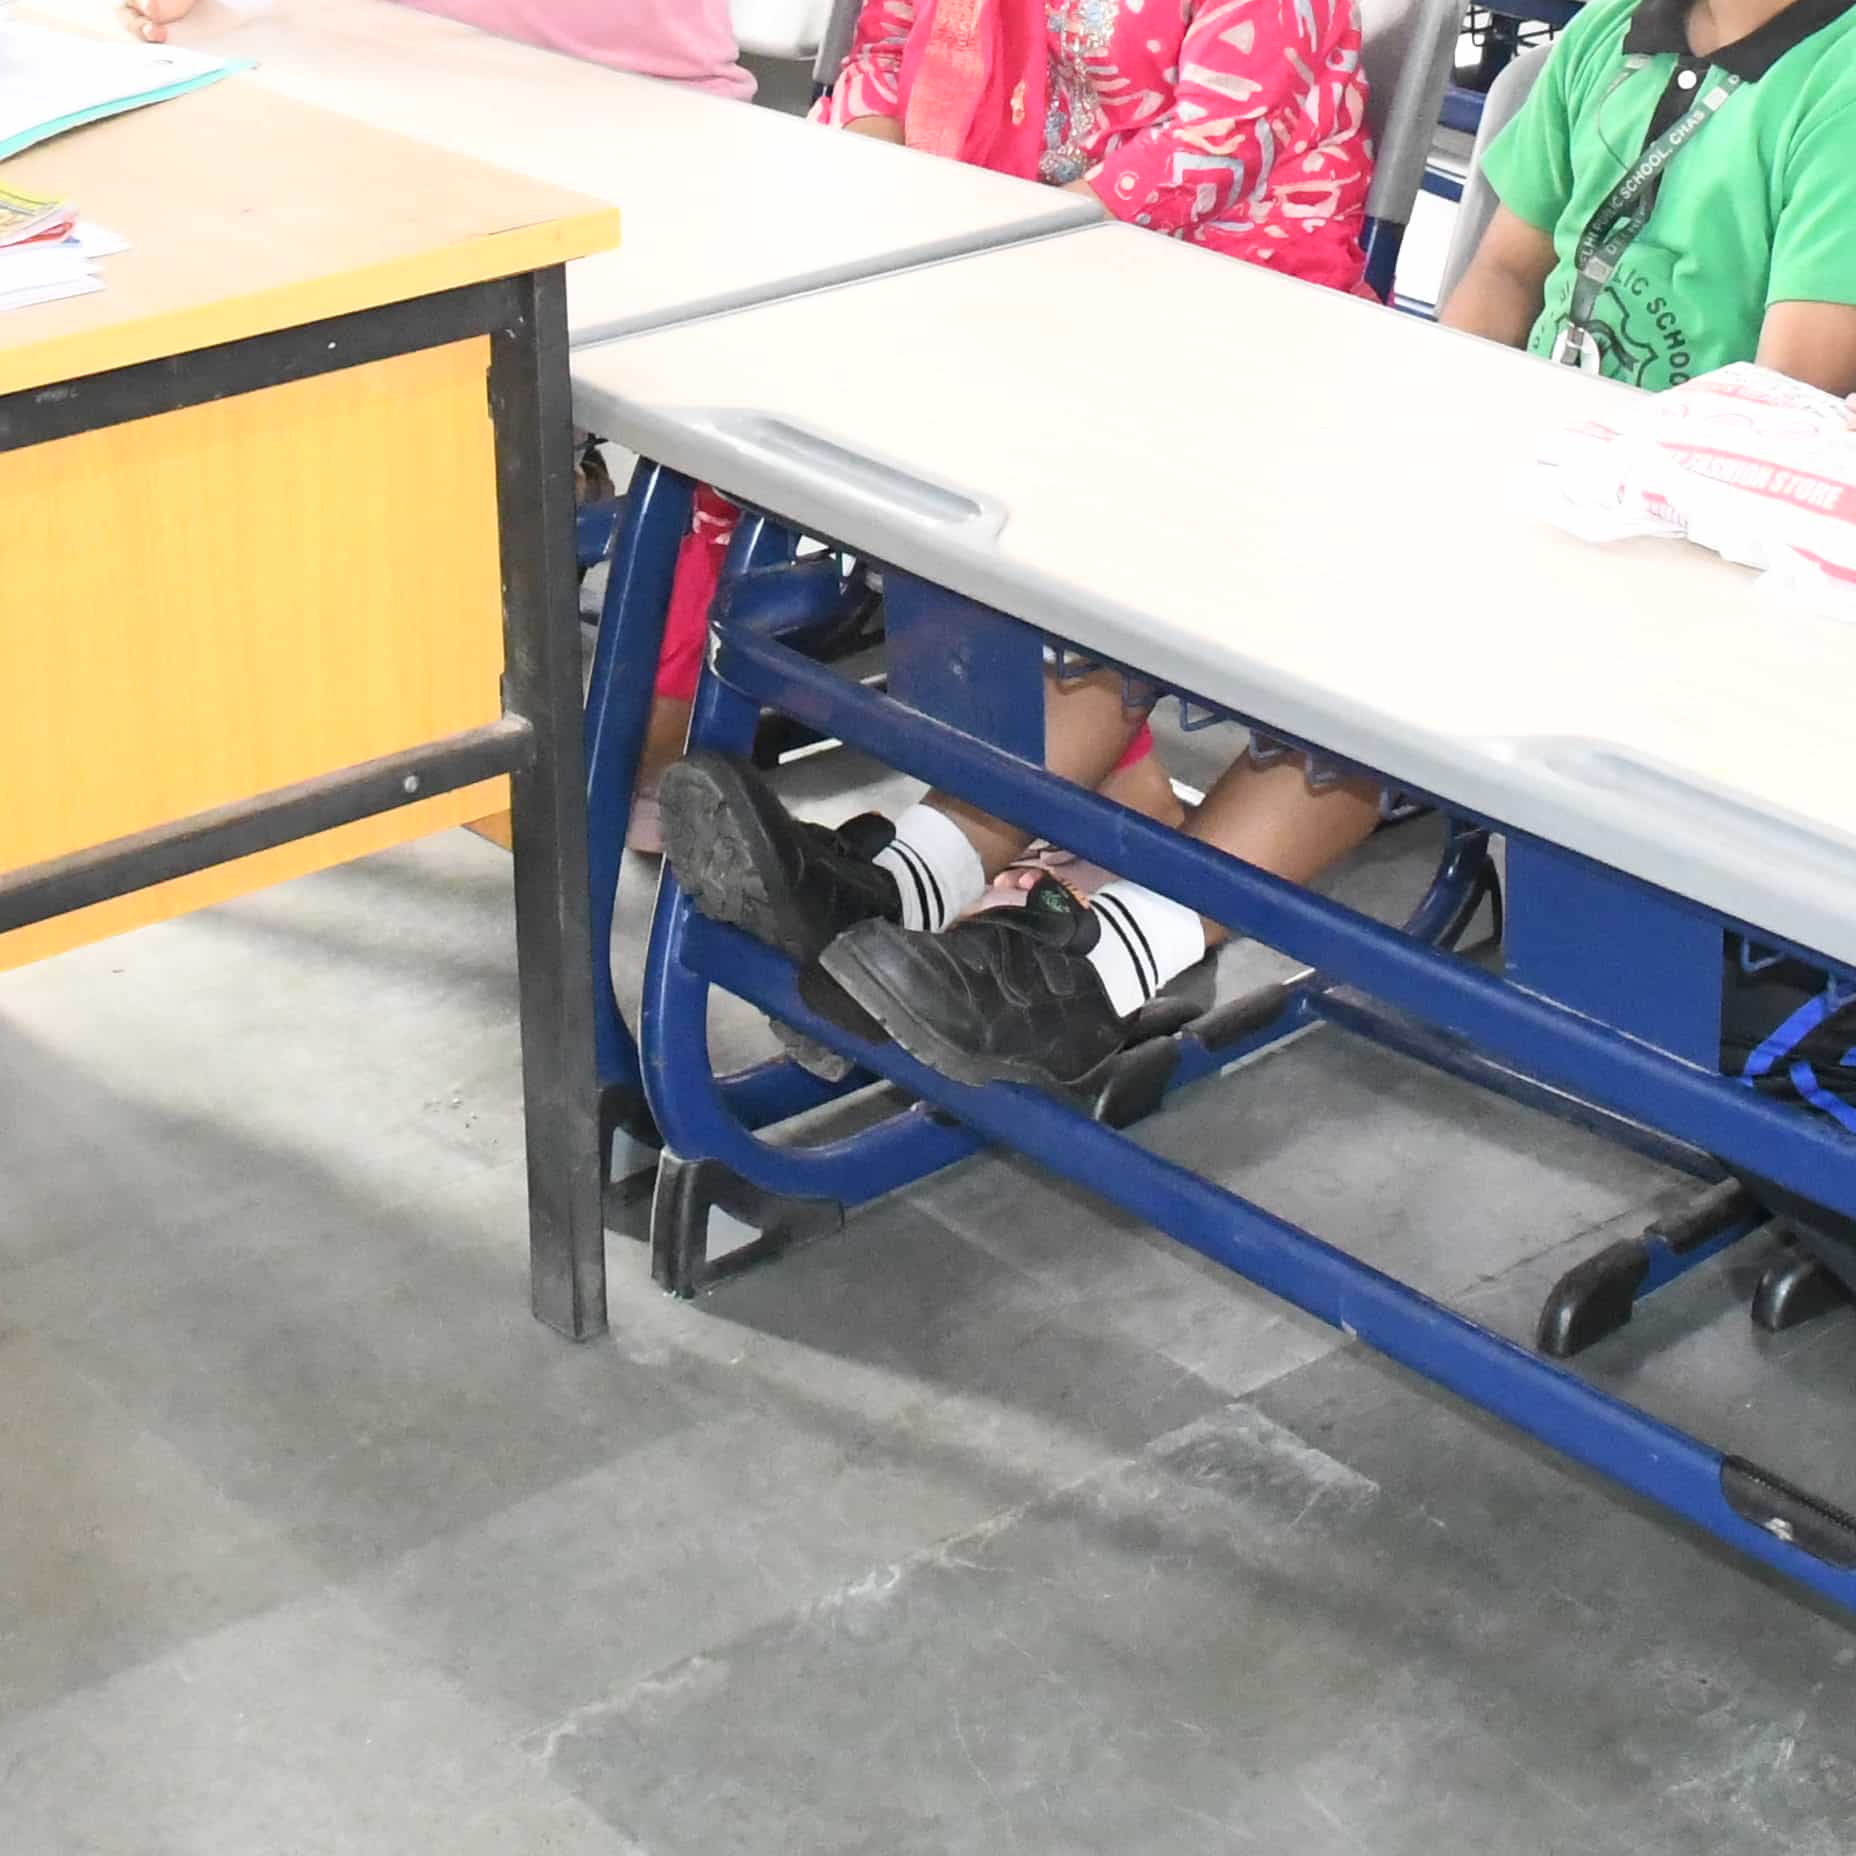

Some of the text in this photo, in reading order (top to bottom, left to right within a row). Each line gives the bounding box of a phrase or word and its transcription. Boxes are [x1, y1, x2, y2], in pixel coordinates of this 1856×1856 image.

[1668, 109, 1706, 146] CHAS
[1646, 297, 1691, 386] SCHOO
[1770, 470, 1844, 511] STORE
